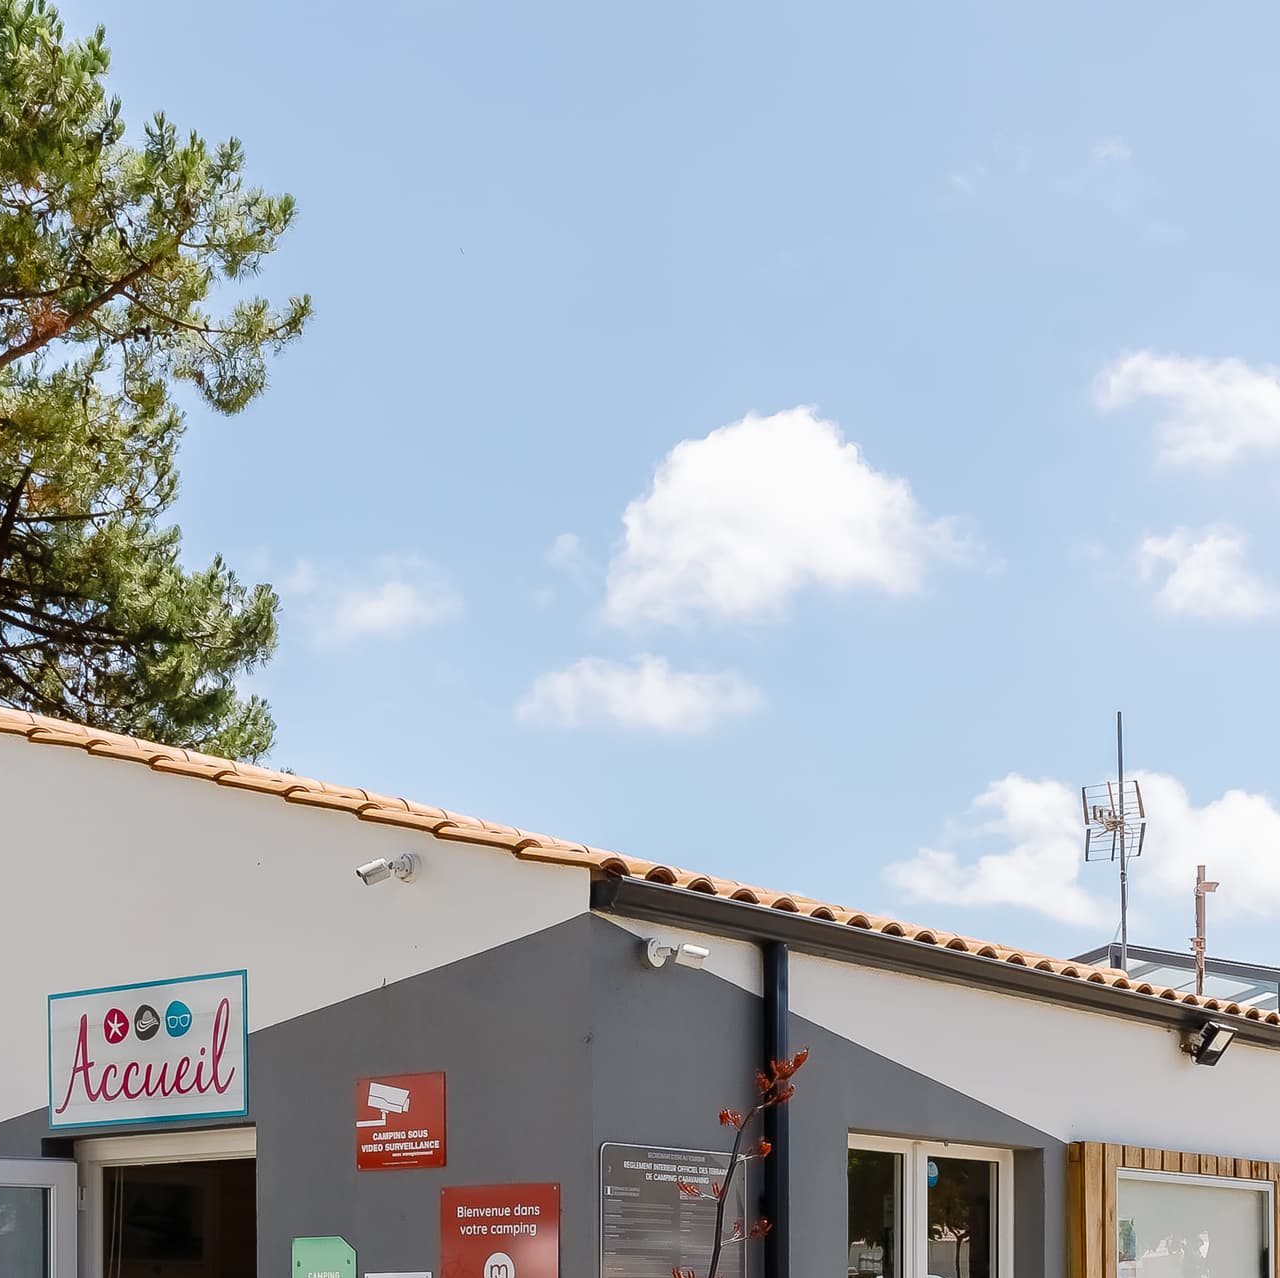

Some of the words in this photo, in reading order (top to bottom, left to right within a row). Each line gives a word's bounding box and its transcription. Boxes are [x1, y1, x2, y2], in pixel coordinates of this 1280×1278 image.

[55, 998, 235, 1113] Accueil
[372, 1131, 406, 1141] CAMPING
[407, 1130, 428, 1138] SOUS
[361, 1144, 383, 1152] VIDEO
[385, 1140, 440, 1152] SURVEILLANCE
[653, 1174, 677, 1182] CAMPING
[709, 1168, 728, 1176] TERRAIN
[457, 1206, 511, 1218] Bienvenue
[514, 1204, 540, 1216] dans
[460, 1224, 488, 1235] votre
[490, 1222, 537, 1236] camping
